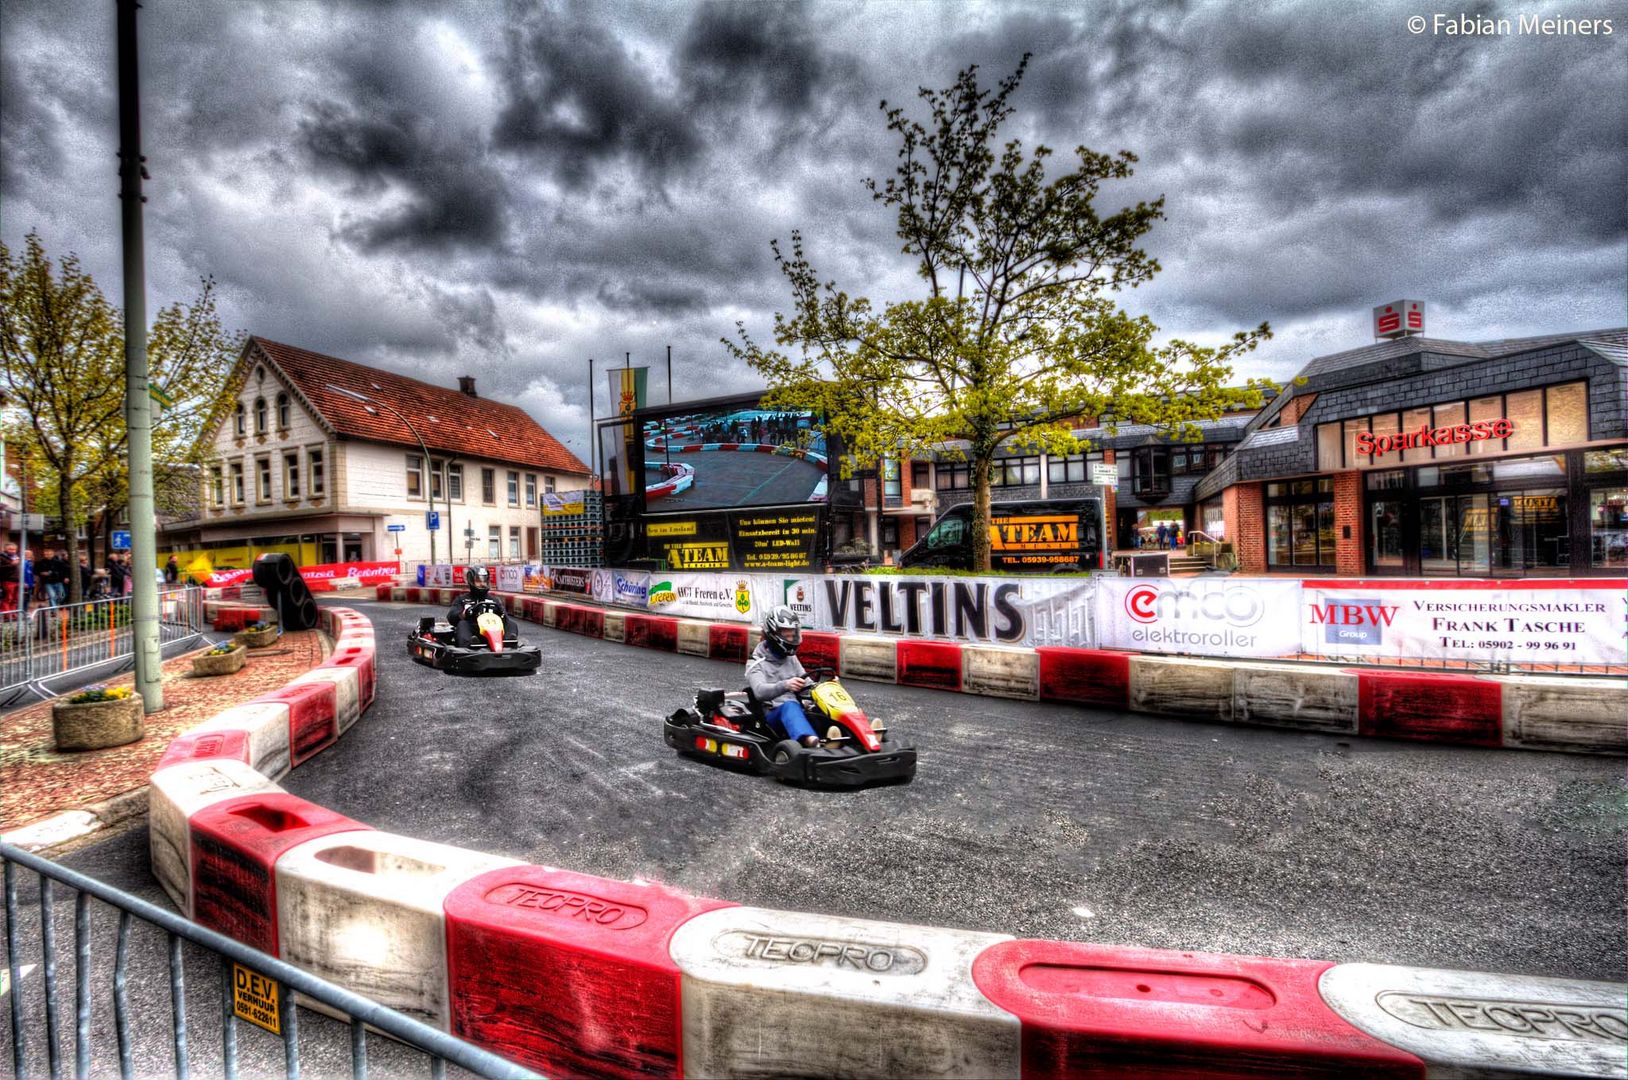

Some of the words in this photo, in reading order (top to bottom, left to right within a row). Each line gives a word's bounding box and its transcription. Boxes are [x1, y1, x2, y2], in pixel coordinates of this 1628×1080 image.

[1356, 418, 1514, 457] Sparkasse
[1003, 523, 1079, 543] TEAM
[681, 547, 728, 562] TEAM
[694, 587, 718, 600] Freren
[790, 604, 812, 612] VELTINS
[825, 580, 1026, 642] VELTINS
[1127, 585, 1263, 625] emco
[1309, 603, 1400, 627] MBW
[1132, 628, 1258, 648] elektroroller
[1339, 630, 1368, 640] Group
[1478, 640, 1514, 650] 05902
[1526, 641, 1541, 650] 99
[1544, 641, 1559, 650] 96
[1562, 641, 1577, 651] 91
[829, 691, 847, 702] 16
[505, 887, 626, 926] TECPRO
[744, 935, 894, 973] TECPRO
[237, 989, 275, 1014] VERHUUR
[1407, 999, 1628, 1041] TECPRO
